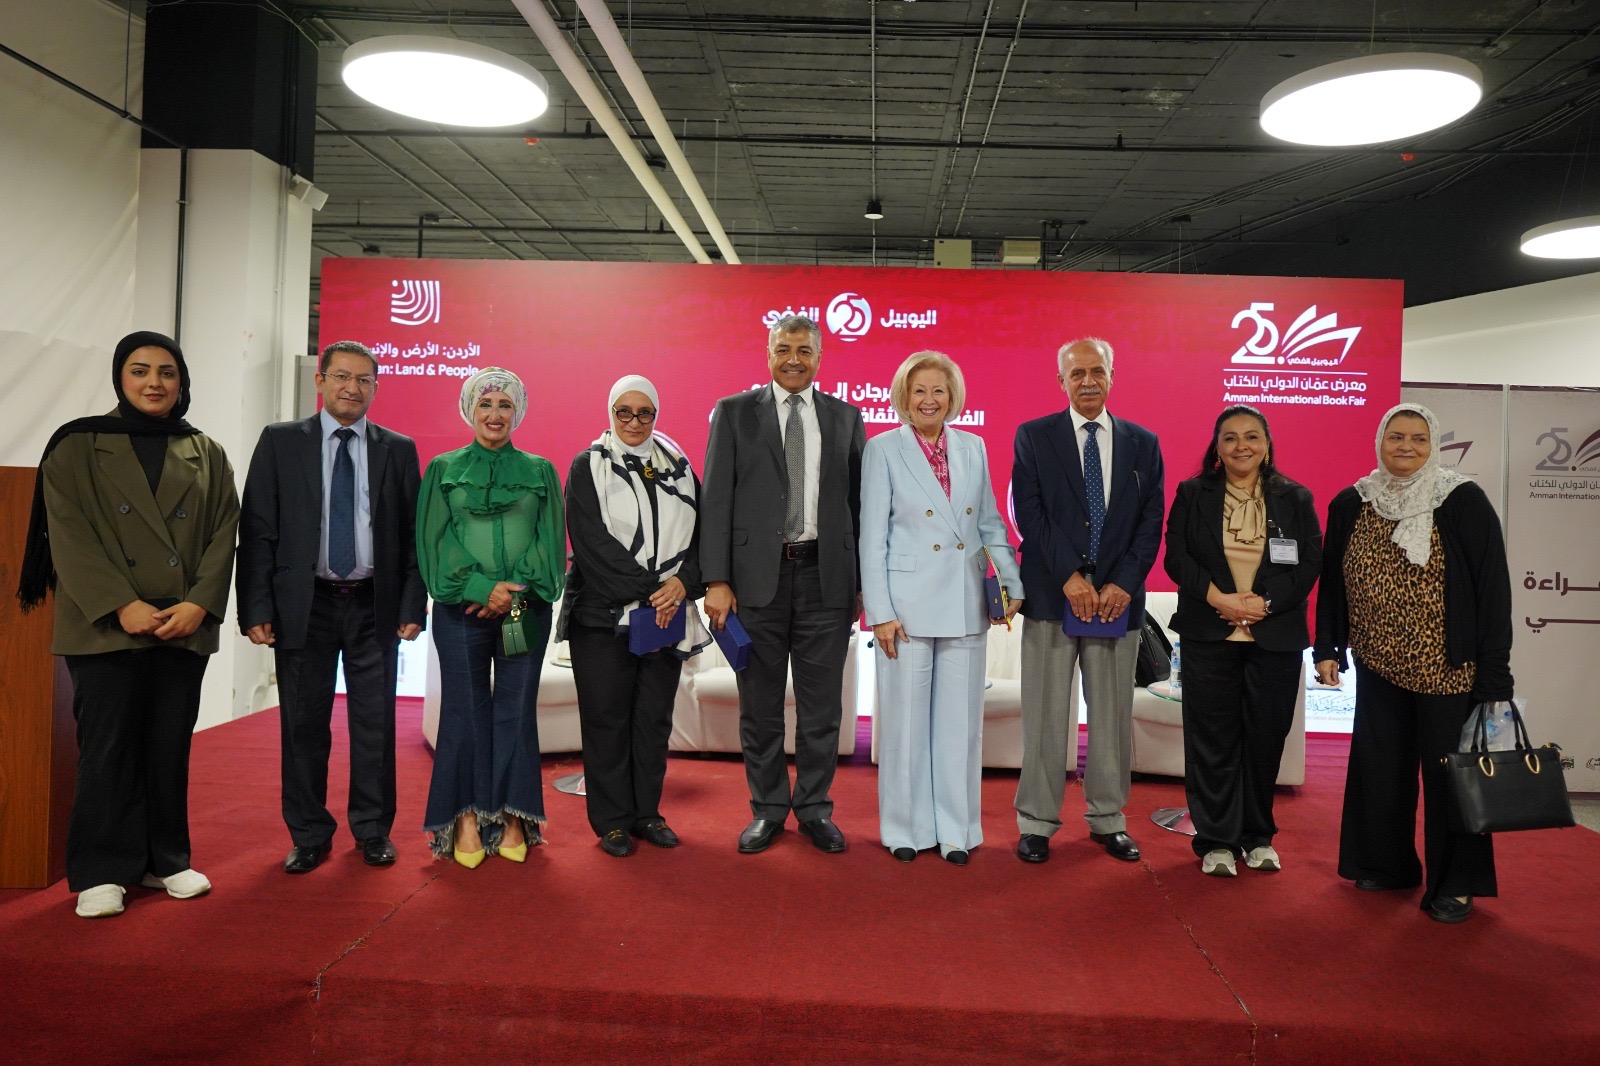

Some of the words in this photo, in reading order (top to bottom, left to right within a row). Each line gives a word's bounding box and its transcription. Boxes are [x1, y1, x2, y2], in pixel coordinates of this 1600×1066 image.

[880, 309, 937, 329] اليوبيل
[1231, 302, 1279, 365] 25
[402, 341, 439, 358] الأرض
[442, 342, 480, 359] الأردن:
[1287, 357, 1311, 366] الفضي
[1311, 357, 1338, 367] اليوبيل
[395, 363, 424, 375] Land
[426, 364, 436, 375] &
[438, 364, 479, 379] People
[1223, 375, 1259, 389] للكتاب
[1260, 376, 1299, 391] الدولي
[1330, 378, 1367, 392] معرض
[1223, 392, 1260, 403] Amman
[1261, 394, 1322, 405] International
[1322, 395, 1348, 406] Book
[1348, 396, 1367, 406] Fair
[1535, 427, 1573, 472] 25
[1529, 479, 1557, 490] للكتاب
[1558, 480, 1588, 491] الدولي
[1529, 491, 1558, 499] Amman
[1559, 492, 1600, 500] Internation
